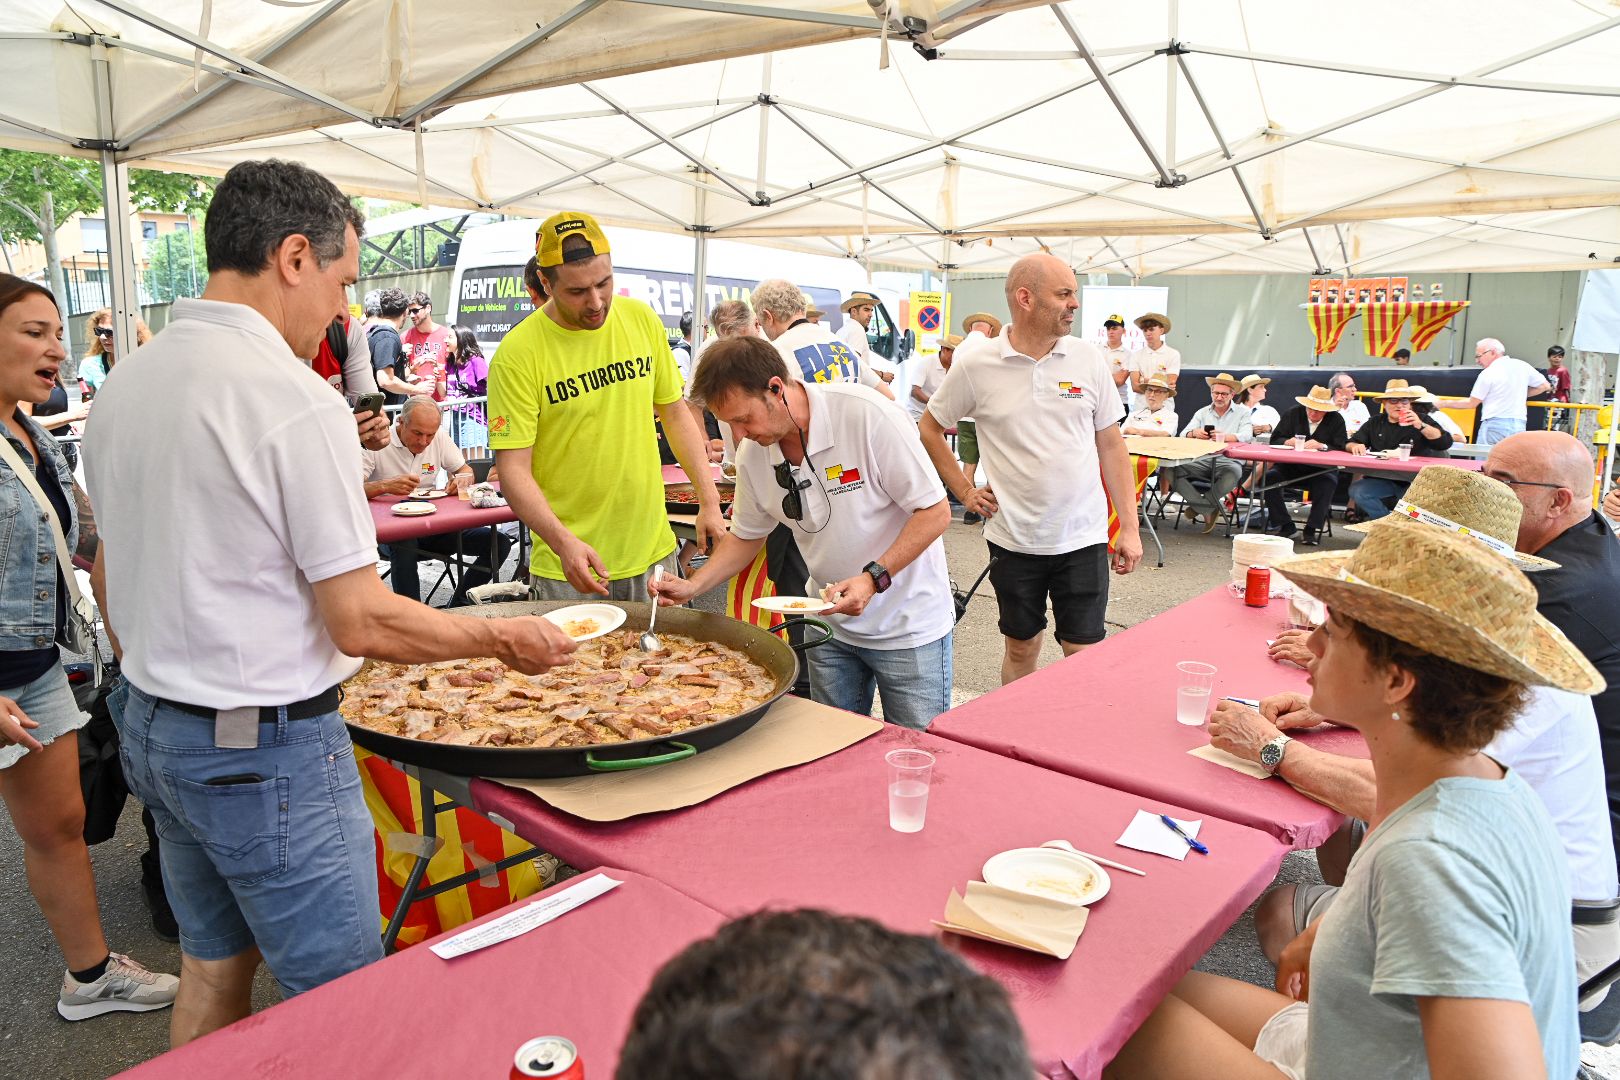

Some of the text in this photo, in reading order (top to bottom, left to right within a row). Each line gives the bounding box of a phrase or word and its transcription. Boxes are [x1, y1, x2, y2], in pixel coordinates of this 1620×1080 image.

[476, 324, 511, 332] SANT CUGAT
[414, 342, 441, 356] GAP
[545, 378, 580, 404] LOS
[578, 360, 636, 393] TURCOS
